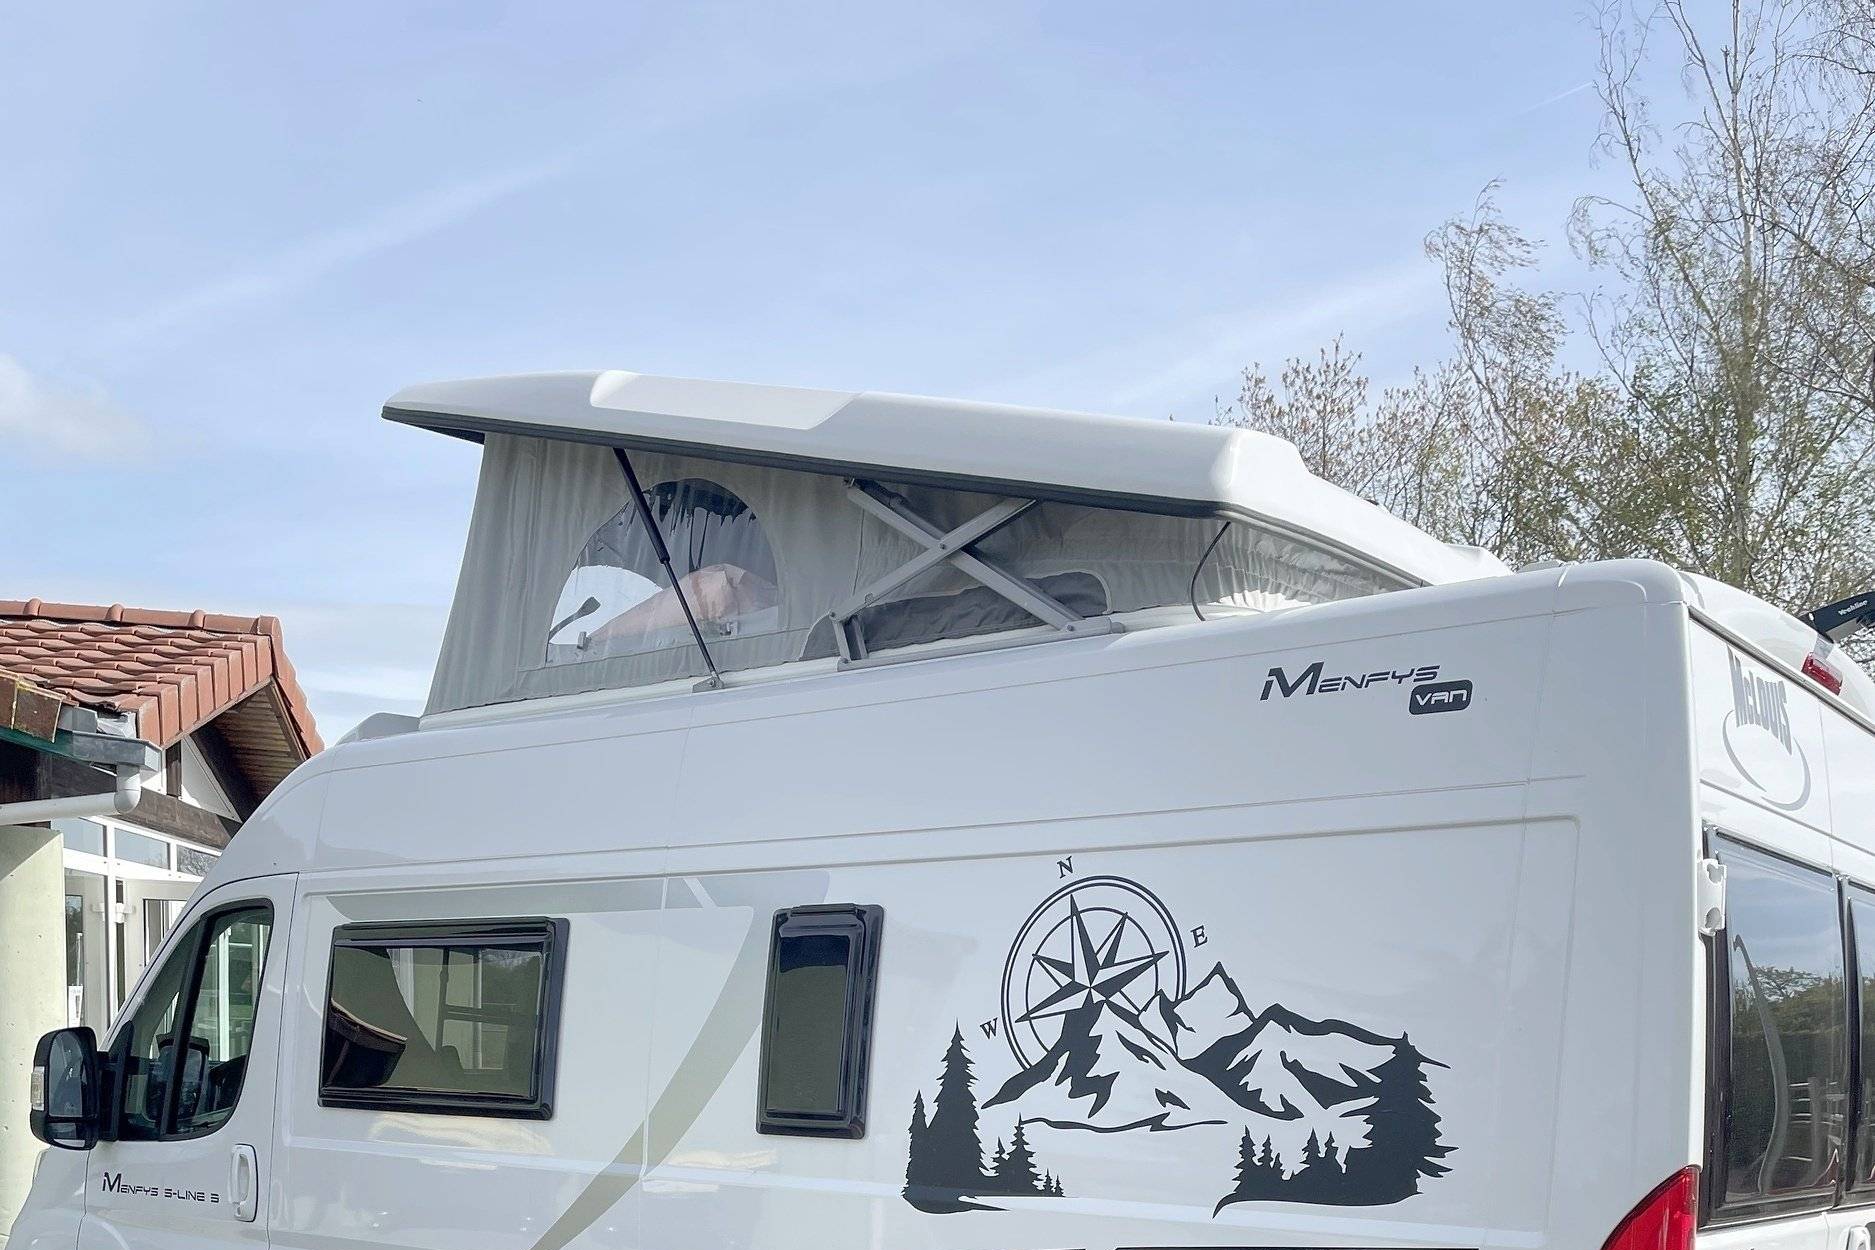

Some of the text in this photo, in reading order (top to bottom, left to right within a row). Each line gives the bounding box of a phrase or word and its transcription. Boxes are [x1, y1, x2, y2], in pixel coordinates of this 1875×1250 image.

[1056, 856, 1075, 879] N
[1190, 925, 1209, 948] E
[979, 1018, 999, 1040] W
